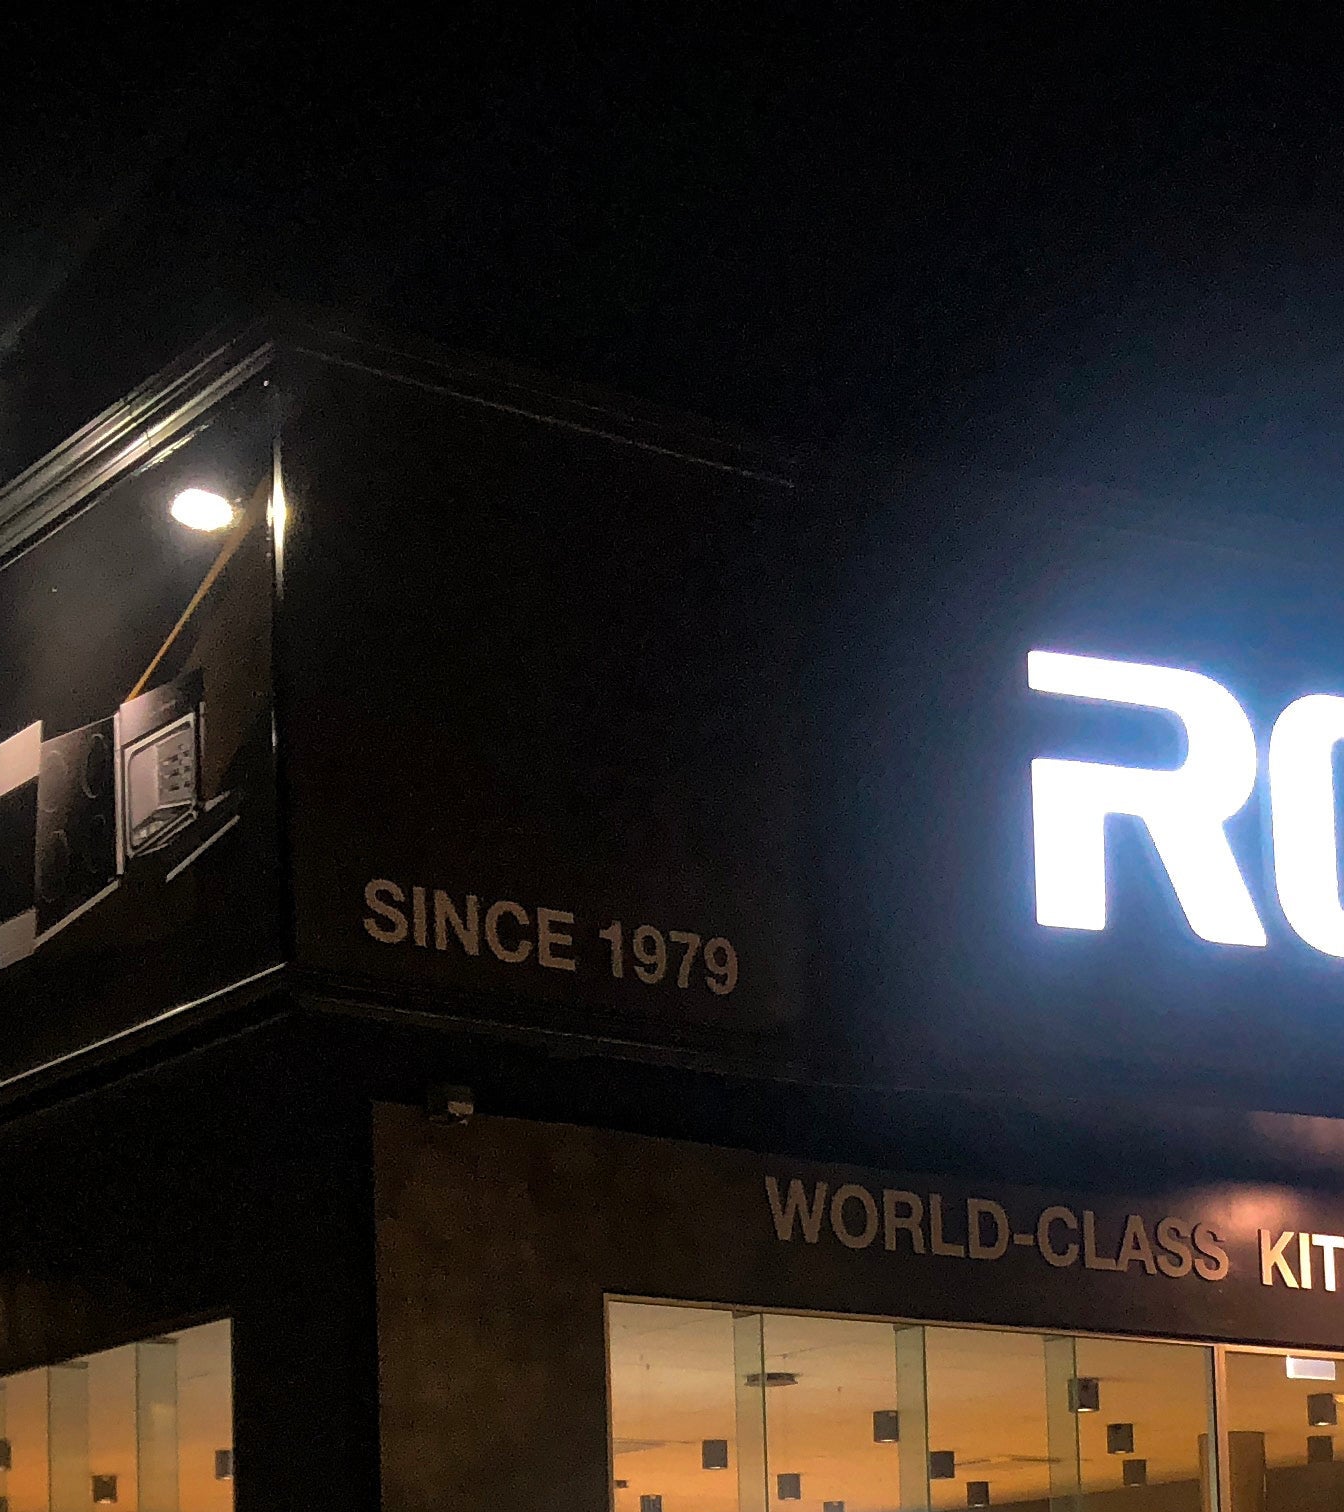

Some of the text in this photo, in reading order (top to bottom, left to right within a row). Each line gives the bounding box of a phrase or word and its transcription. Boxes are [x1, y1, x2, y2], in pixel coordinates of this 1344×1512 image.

[364, 878, 739, 995] SINCE 1979
[765, 1175, 1229, 1282] WORLD-CLASS
